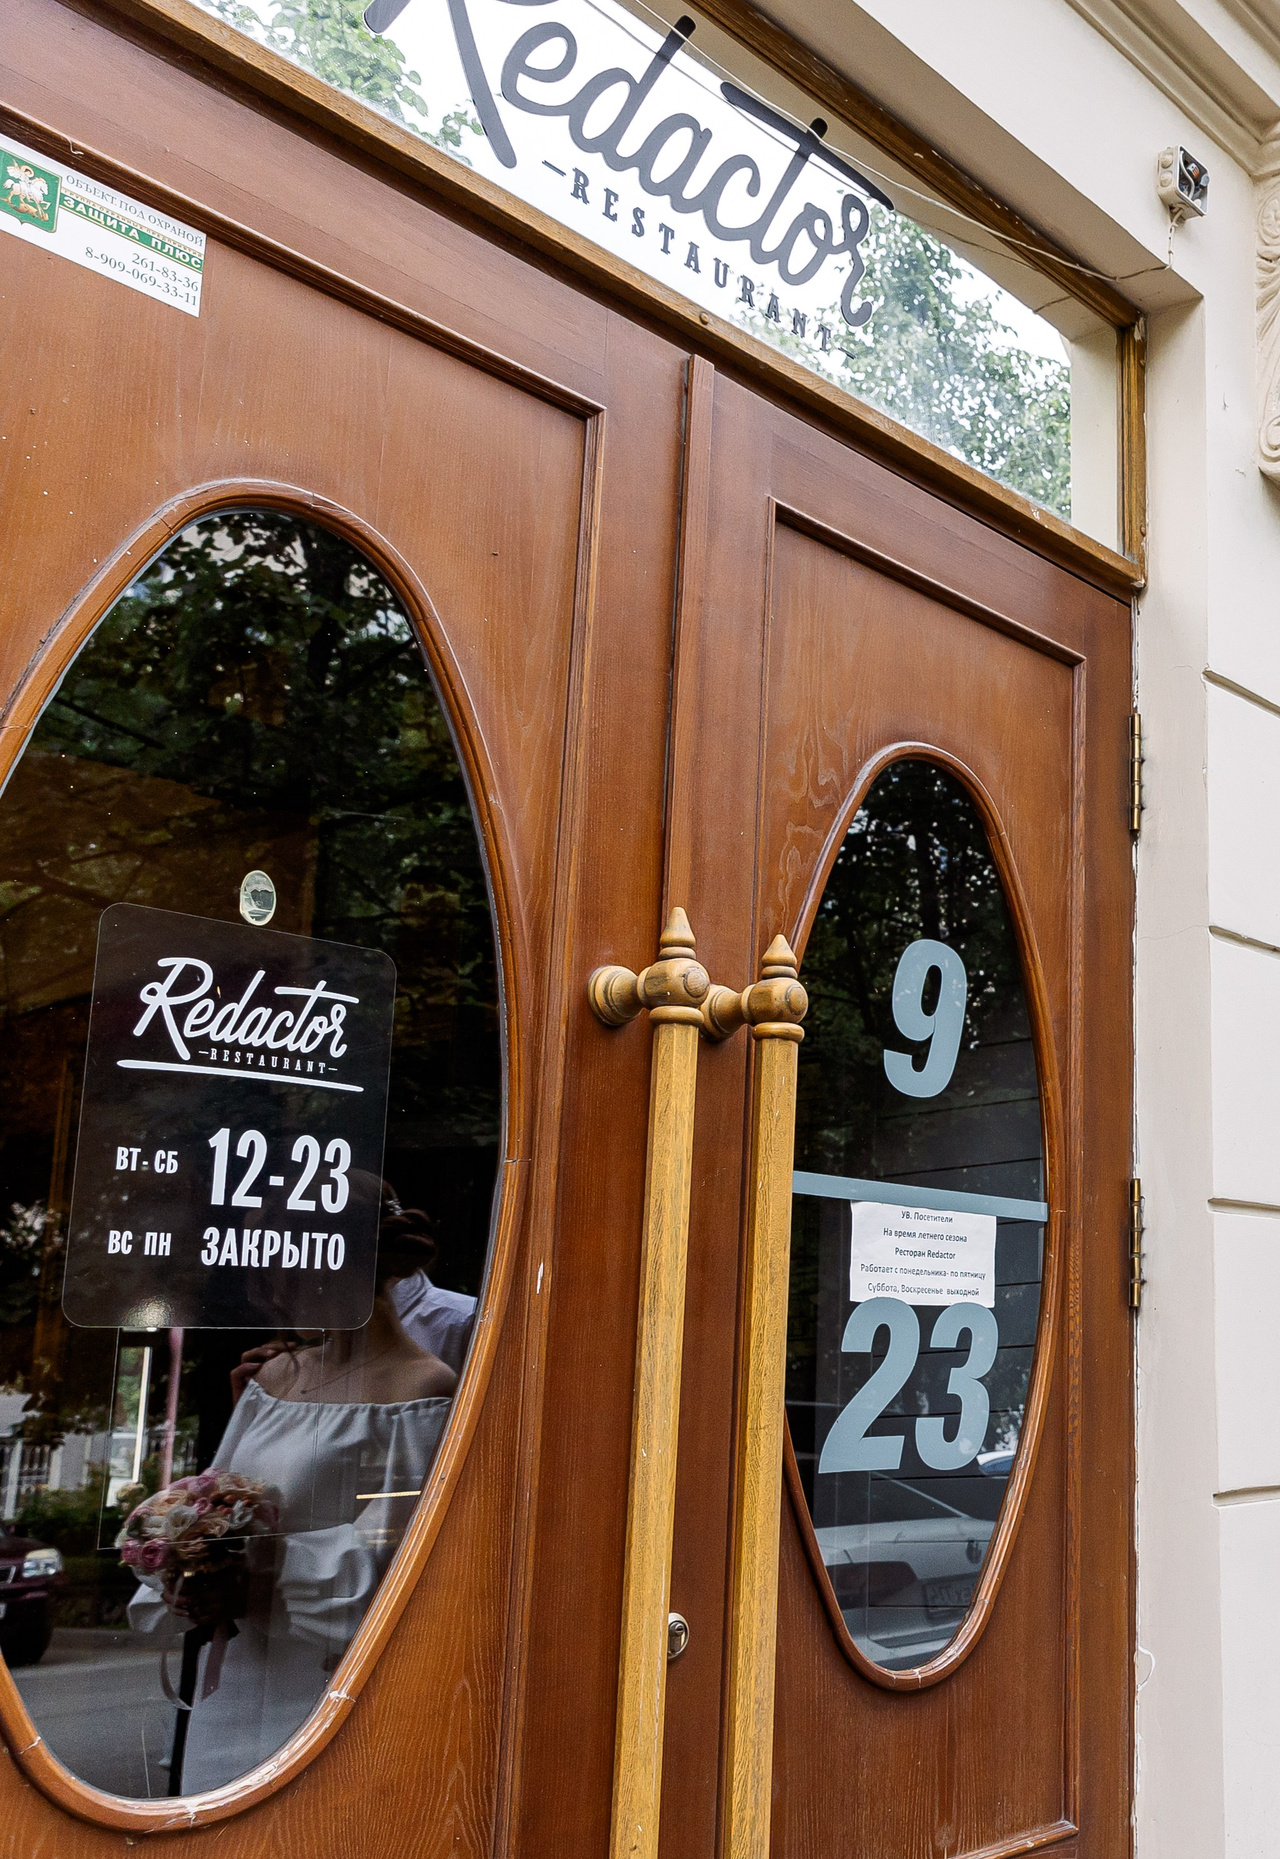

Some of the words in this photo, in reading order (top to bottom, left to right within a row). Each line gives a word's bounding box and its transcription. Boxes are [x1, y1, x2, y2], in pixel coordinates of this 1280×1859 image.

[63, 196, 140, 240] ЗАЩИТА
[151, 237, 202, 268] ПЛЮС
[120, 200, 145, 220] ПОД
[148, 214, 203, 247] ОХРАНОЙ
[85, 246, 197, 306] 8-909-069-33-11
[131, 252, 199, 292] 261-83-36
[132, 956, 359, 1061] Redactor
[883, 938, 968, 1098] 9
[207, 1127, 352, 1214] 12-23
[883, 1227, 893, 1237] На
[894, 1229, 917, 1240] время
[917, 1232, 944, 1242] летнего
[945, 1234, 968, 1243] сезона
[901, 1210, 913, 1220] УВ.
[913, 1211, 954, 1223] Посетители
[107, 1230, 133, 1255] ВС
[143, 1231, 172, 1256] ПН
[200, 1226, 346, 1271] ЗАКРЫТО
[894, 1247, 926, 1258] Ресторан
[926, 1249, 956, 1260] Redactor
[860, 1263, 894, 1274] Работает
[950, 1270, 959, 1278] по
[959, 1271, 986, 1281] пятницу
[867, 1282, 900, 1294] Суббота,
[901, 1284, 944, 1295] Воскресенье
[946, 1286, 980, 1297] выходной
[818, 1296, 999, 1474] 23
